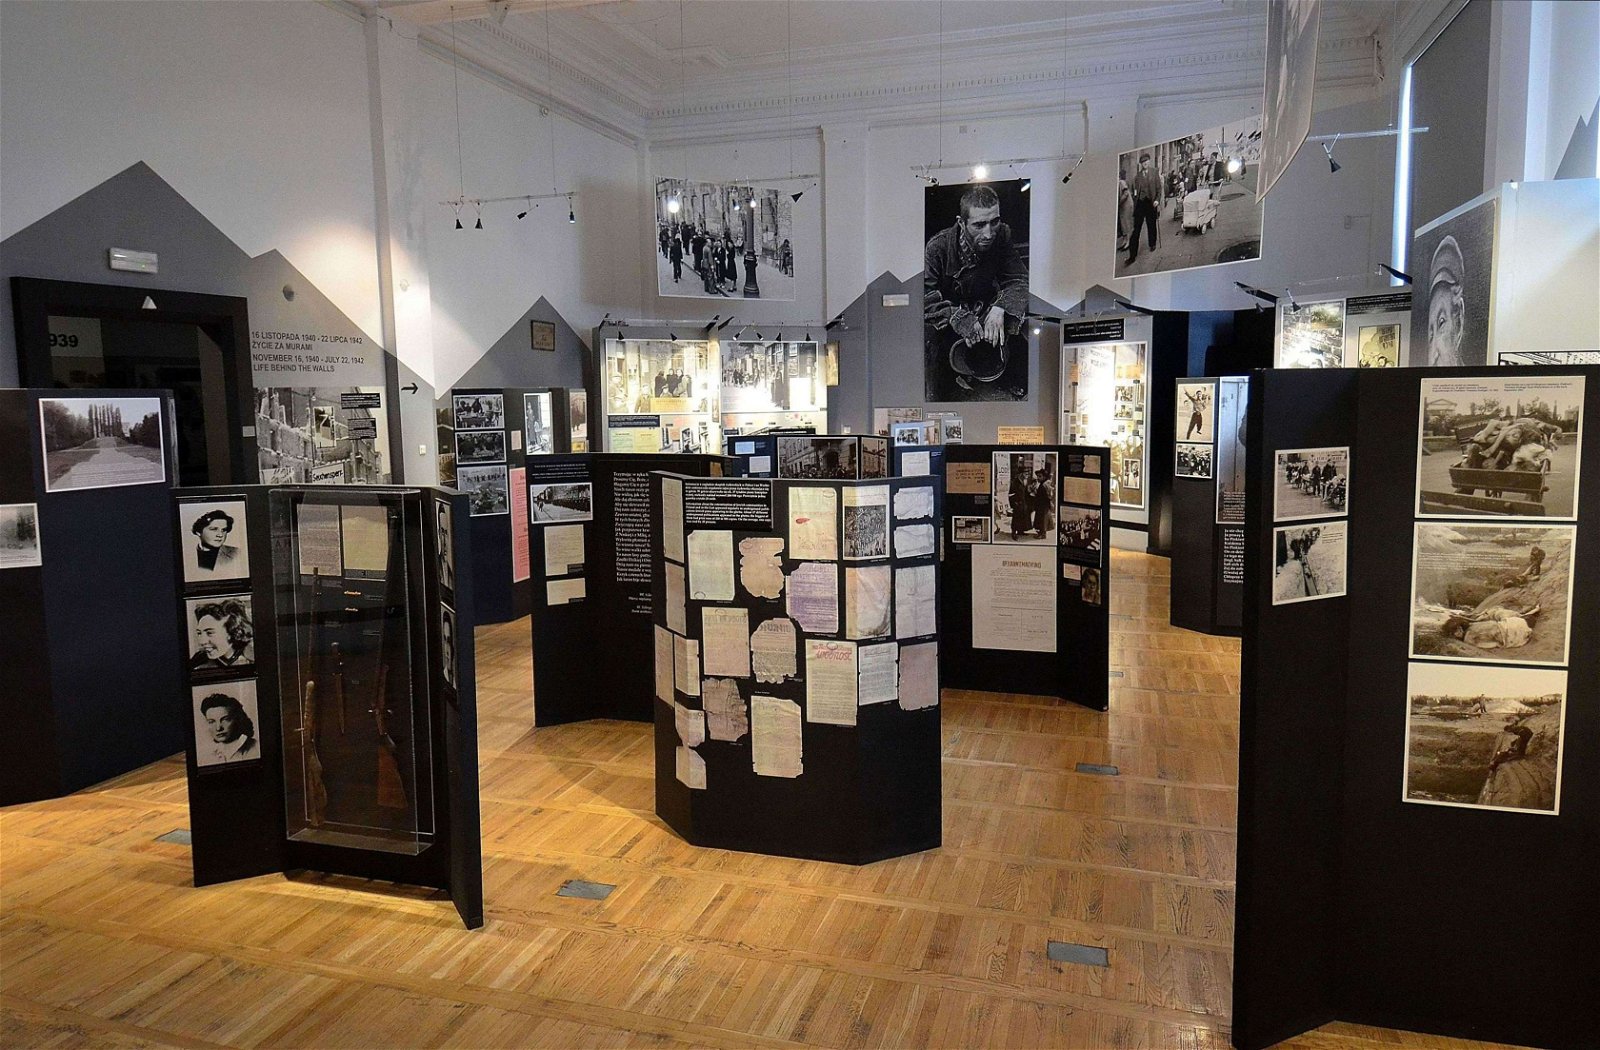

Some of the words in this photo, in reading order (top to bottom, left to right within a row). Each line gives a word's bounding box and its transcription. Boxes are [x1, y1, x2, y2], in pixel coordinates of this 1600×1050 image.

[251, 331, 260, 339] 16
[261, 332, 300, 341] LISTOPADA
[301, 334, 316, 342] 1940
[329, 336, 348, 344] LIPCA
[274, 342, 285, 350] ZA
[252, 354, 293, 362] NOVEMBER
[305, 355, 319, 363] 1940
[324, 356, 340, 364] JULY
[253, 364, 269, 372] LIFE
[271, 364, 297, 372] BEHIND
